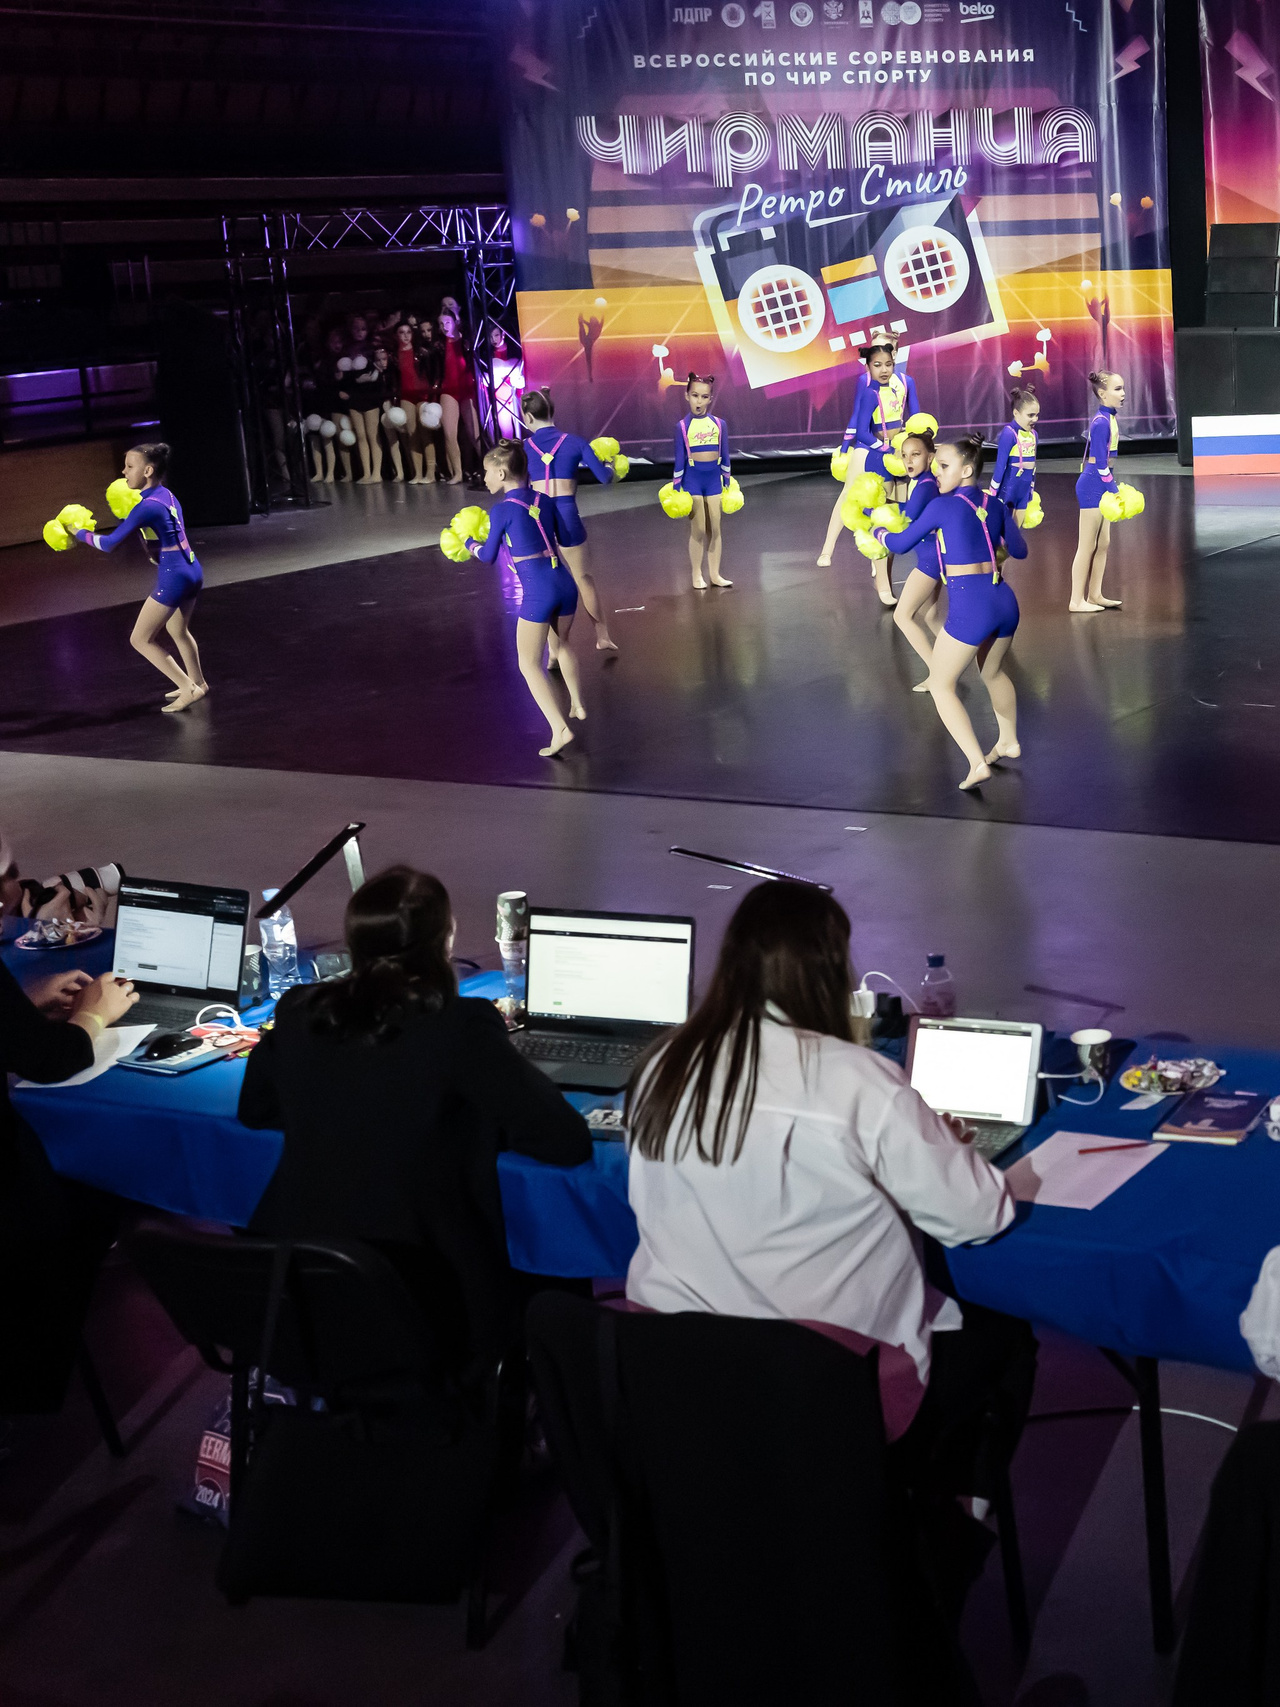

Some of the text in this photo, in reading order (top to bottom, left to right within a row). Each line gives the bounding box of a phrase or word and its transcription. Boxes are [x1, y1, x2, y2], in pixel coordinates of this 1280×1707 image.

[671, 7, 713, 24] ЛДПР
[959, 2, 995, 15] beko
[633, 48, 1035, 69] ВСЕРОССИЙСКИЕ СОРЕВНОВАНИЯ
[744, 69, 933, 87] ПО ЧИР СПОРТУ
[736, 163, 969, 228] Ретро Стиль
